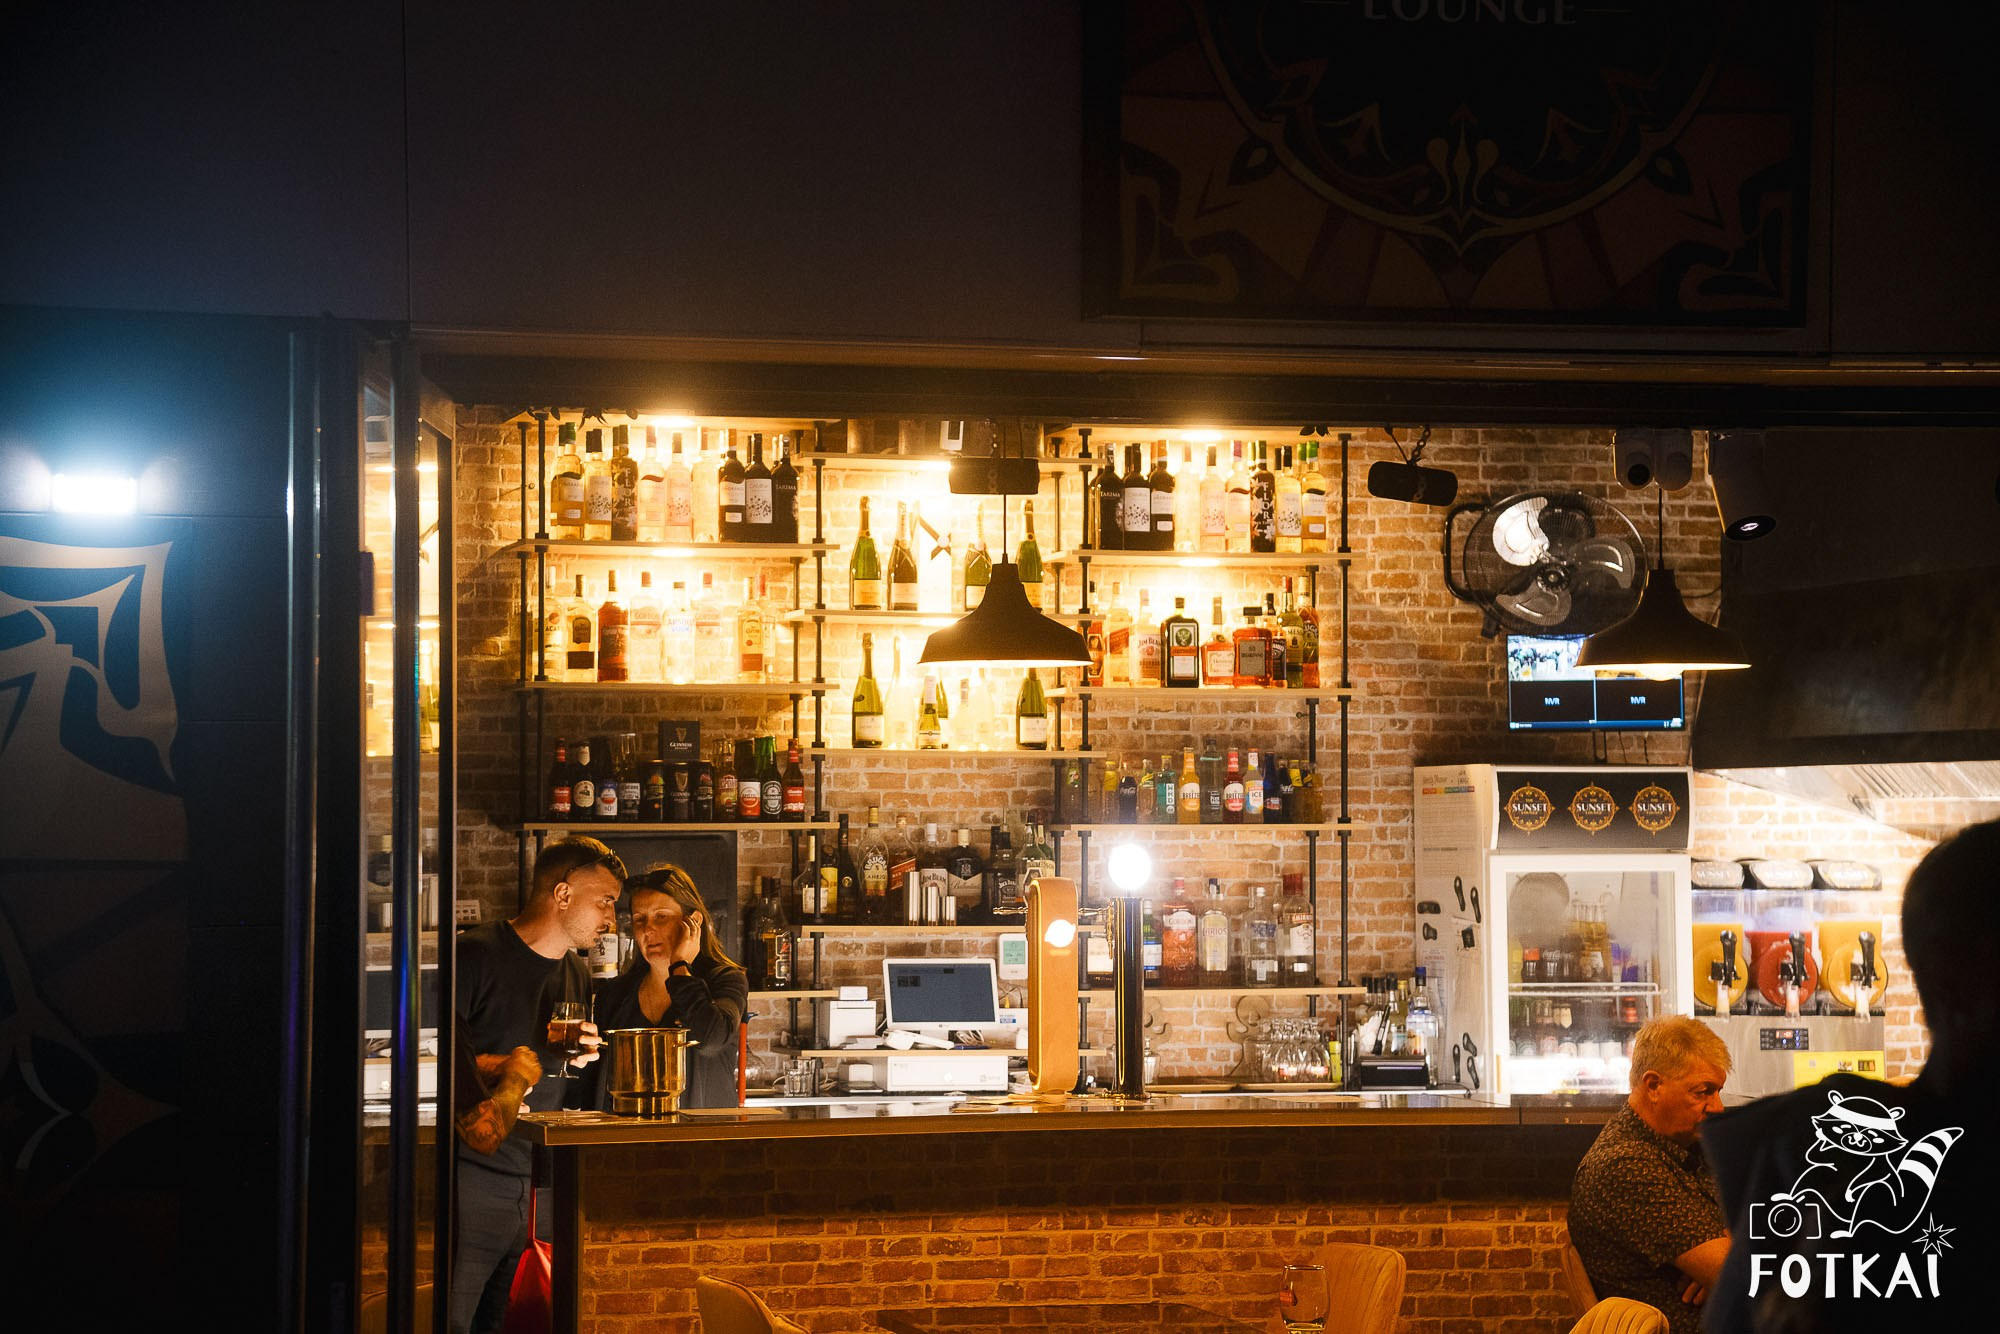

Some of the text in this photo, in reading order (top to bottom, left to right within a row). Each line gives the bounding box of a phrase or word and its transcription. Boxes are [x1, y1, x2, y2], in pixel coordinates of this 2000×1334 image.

[1361, 0, 1577, 25] LOUNGE
[1251, 790, 1262, 798] ICE
[1512, 803, 1548, 812] SUNSET
[1576, 803, 1612, 812] SUNSET
[1637, 803, 1673, 812] SUNSET
